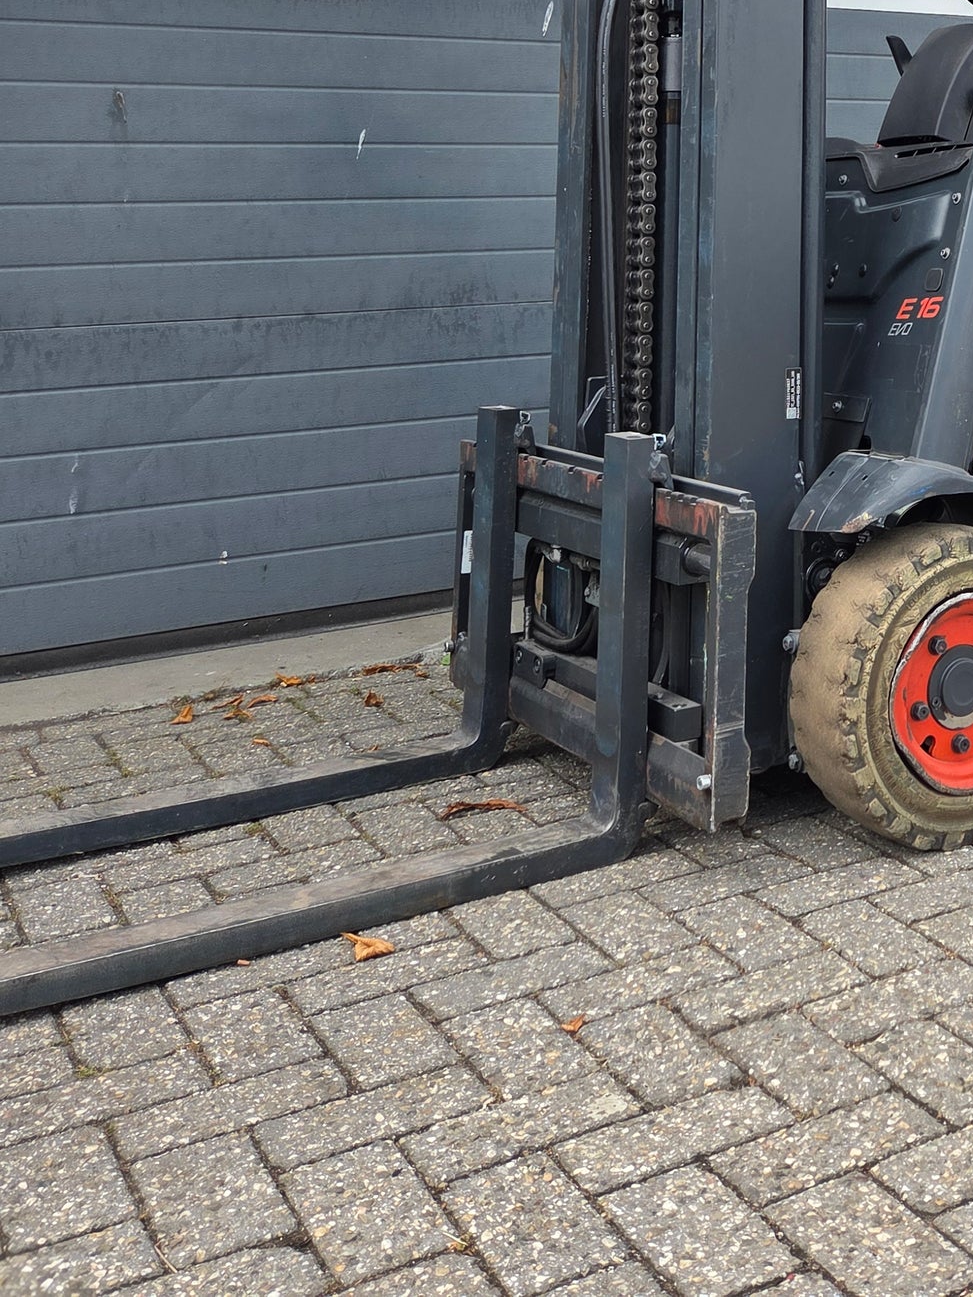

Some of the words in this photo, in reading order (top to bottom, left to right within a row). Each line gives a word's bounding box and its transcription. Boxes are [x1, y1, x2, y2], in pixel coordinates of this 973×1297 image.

[895, 298, 918, 320] E
[916, 296, 944, 319] 16
[887, 322, 913, 336] EVO
